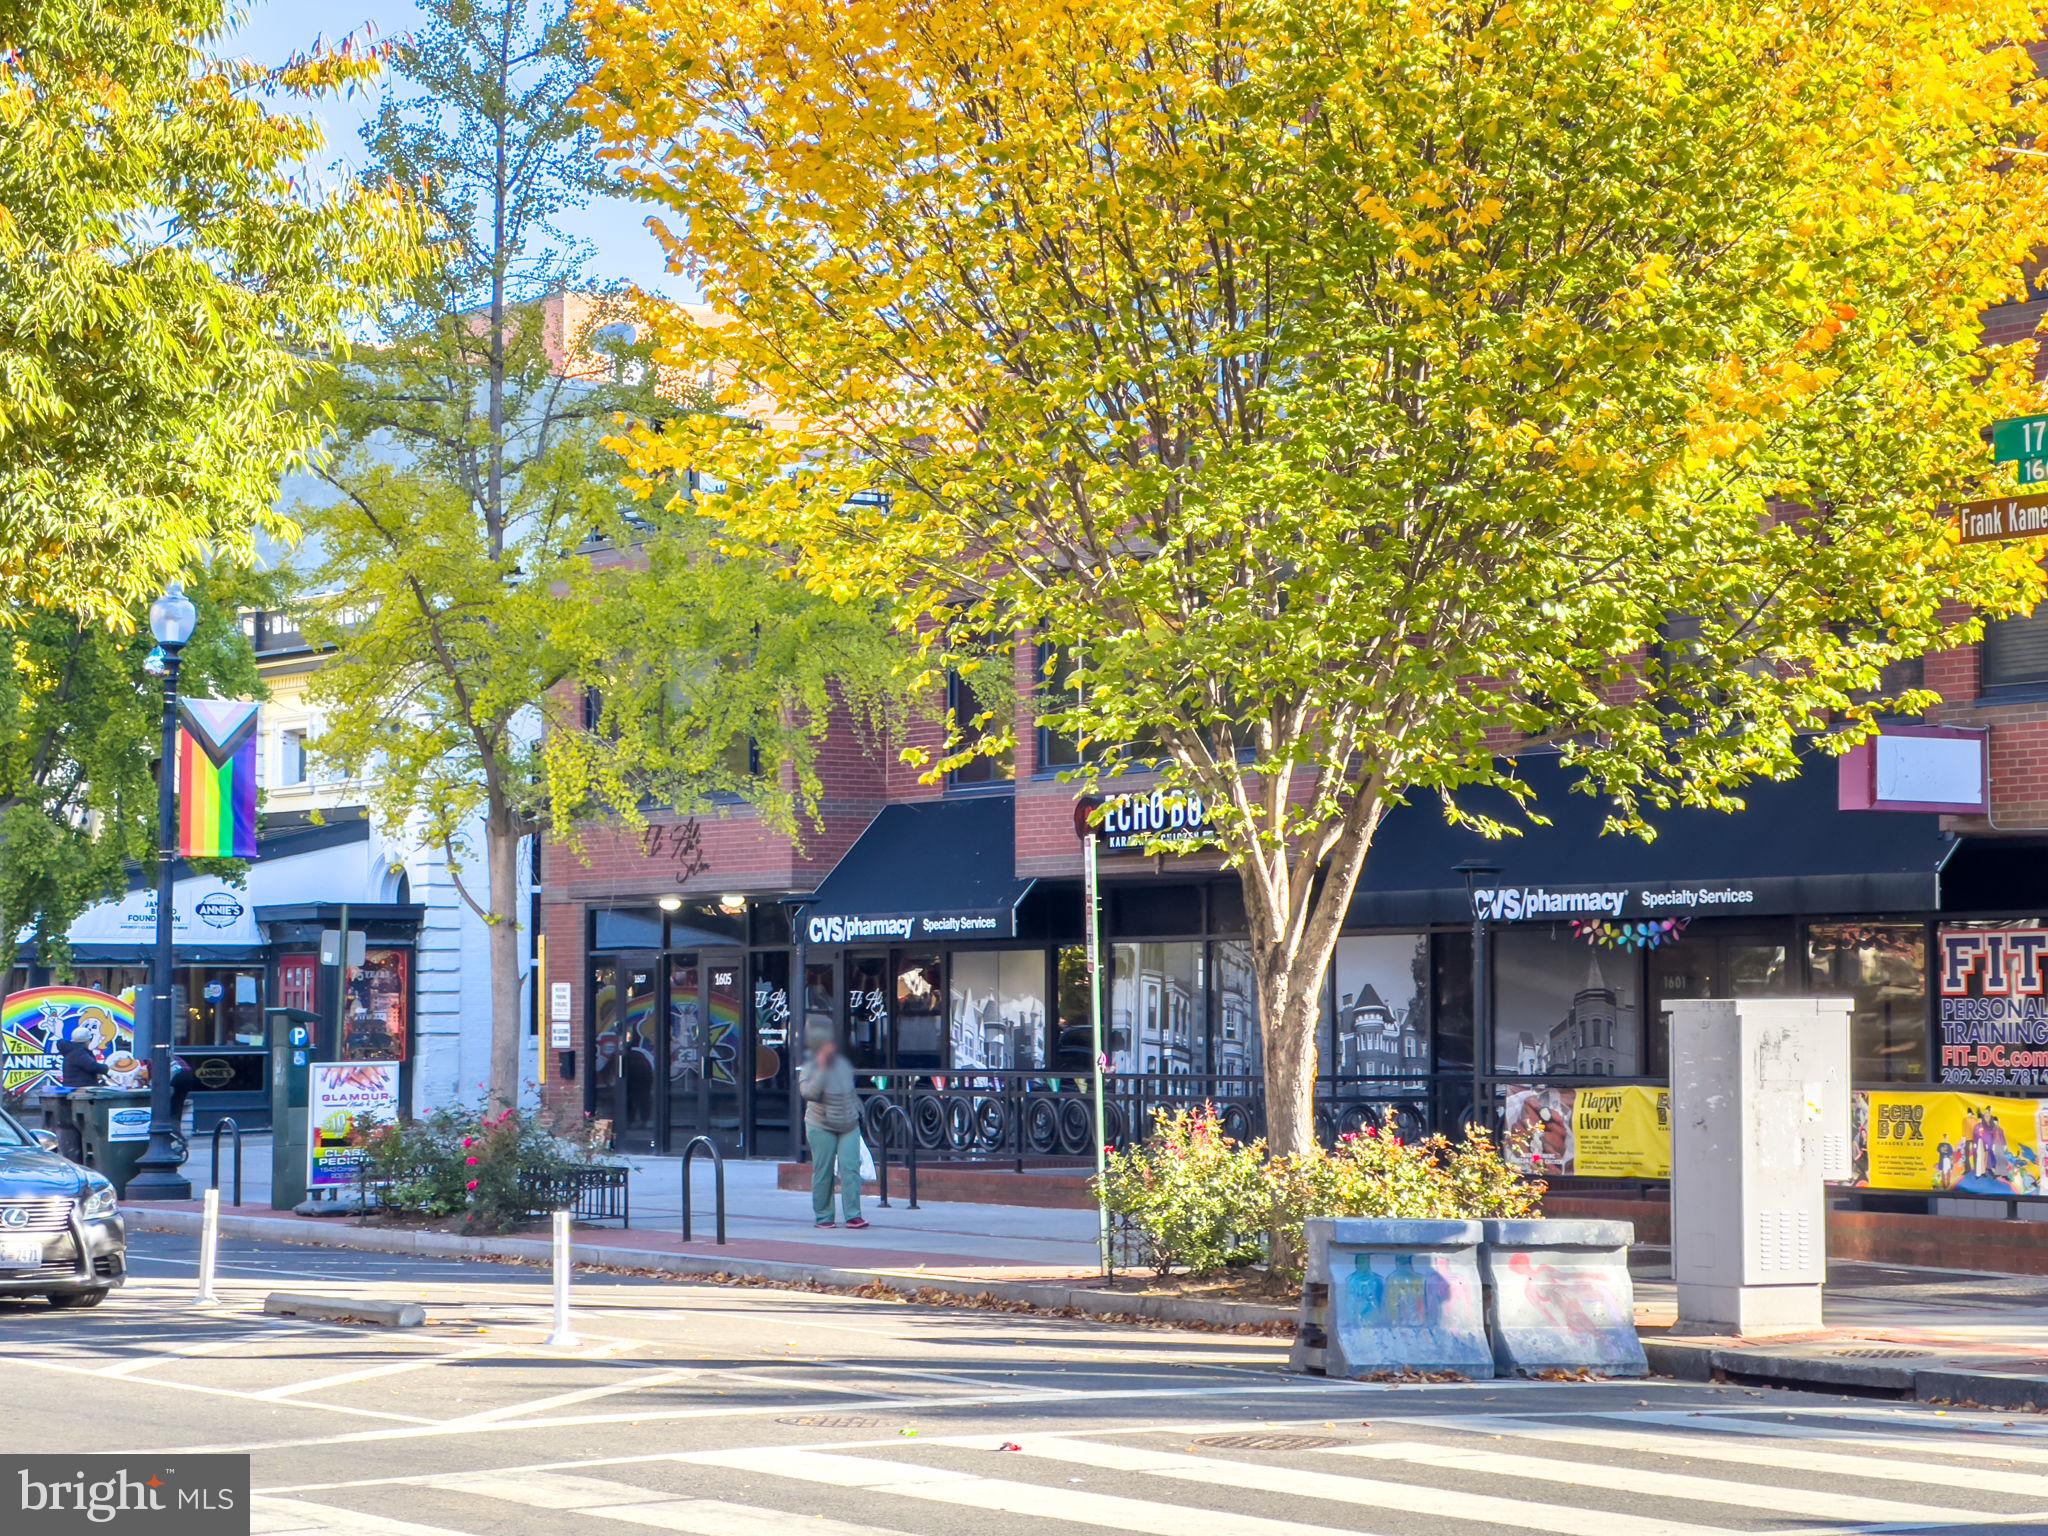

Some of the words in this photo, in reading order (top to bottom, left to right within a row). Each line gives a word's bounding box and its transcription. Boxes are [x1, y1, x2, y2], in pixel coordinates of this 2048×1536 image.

[2025, 459, 2048, 481] 16
[1962, 504, 2003, 538] Frank
[2009, 502, 2048, 532] Kame
[1105, 791, 1164, 832] ECHO
[1171, 789, 1202, 828] BO
[199, 905, 241, 916] ANNIE'S
[1473, 887, 1626, 919] CVS/pharmacy
[1641, 889, 1699, 907] Specialty
[1699, 887, 1754, 904] Services
[809, 915, 914, 942] CVS/pharmacy
[923, 917, 960, 932] Specialty
[960, 916, 996, 930] Services
[1940, 929, 2048, 996] FIT
[714, 972, 732, 986] 1605
[1663, 976, 1687, 989] 1601
[1941, 997, 2048, 1021] PERSONAL
[1941, 1020, 2048, 1045] TRAINING
[3, 1054, 64, 1070] ANNIE'S
[1942, 1045, 2048, 1068] FIT-DC.com
[321, 1092, 389, 1102] GLAMOUR
[1580, 1091, 1622, 1113] Happy
[1579, 1113, 1614, 1131] Hour
[1878, 1104, 1924, 1121] ECHO
[1877, 1120, 1925, 1140] BOX
